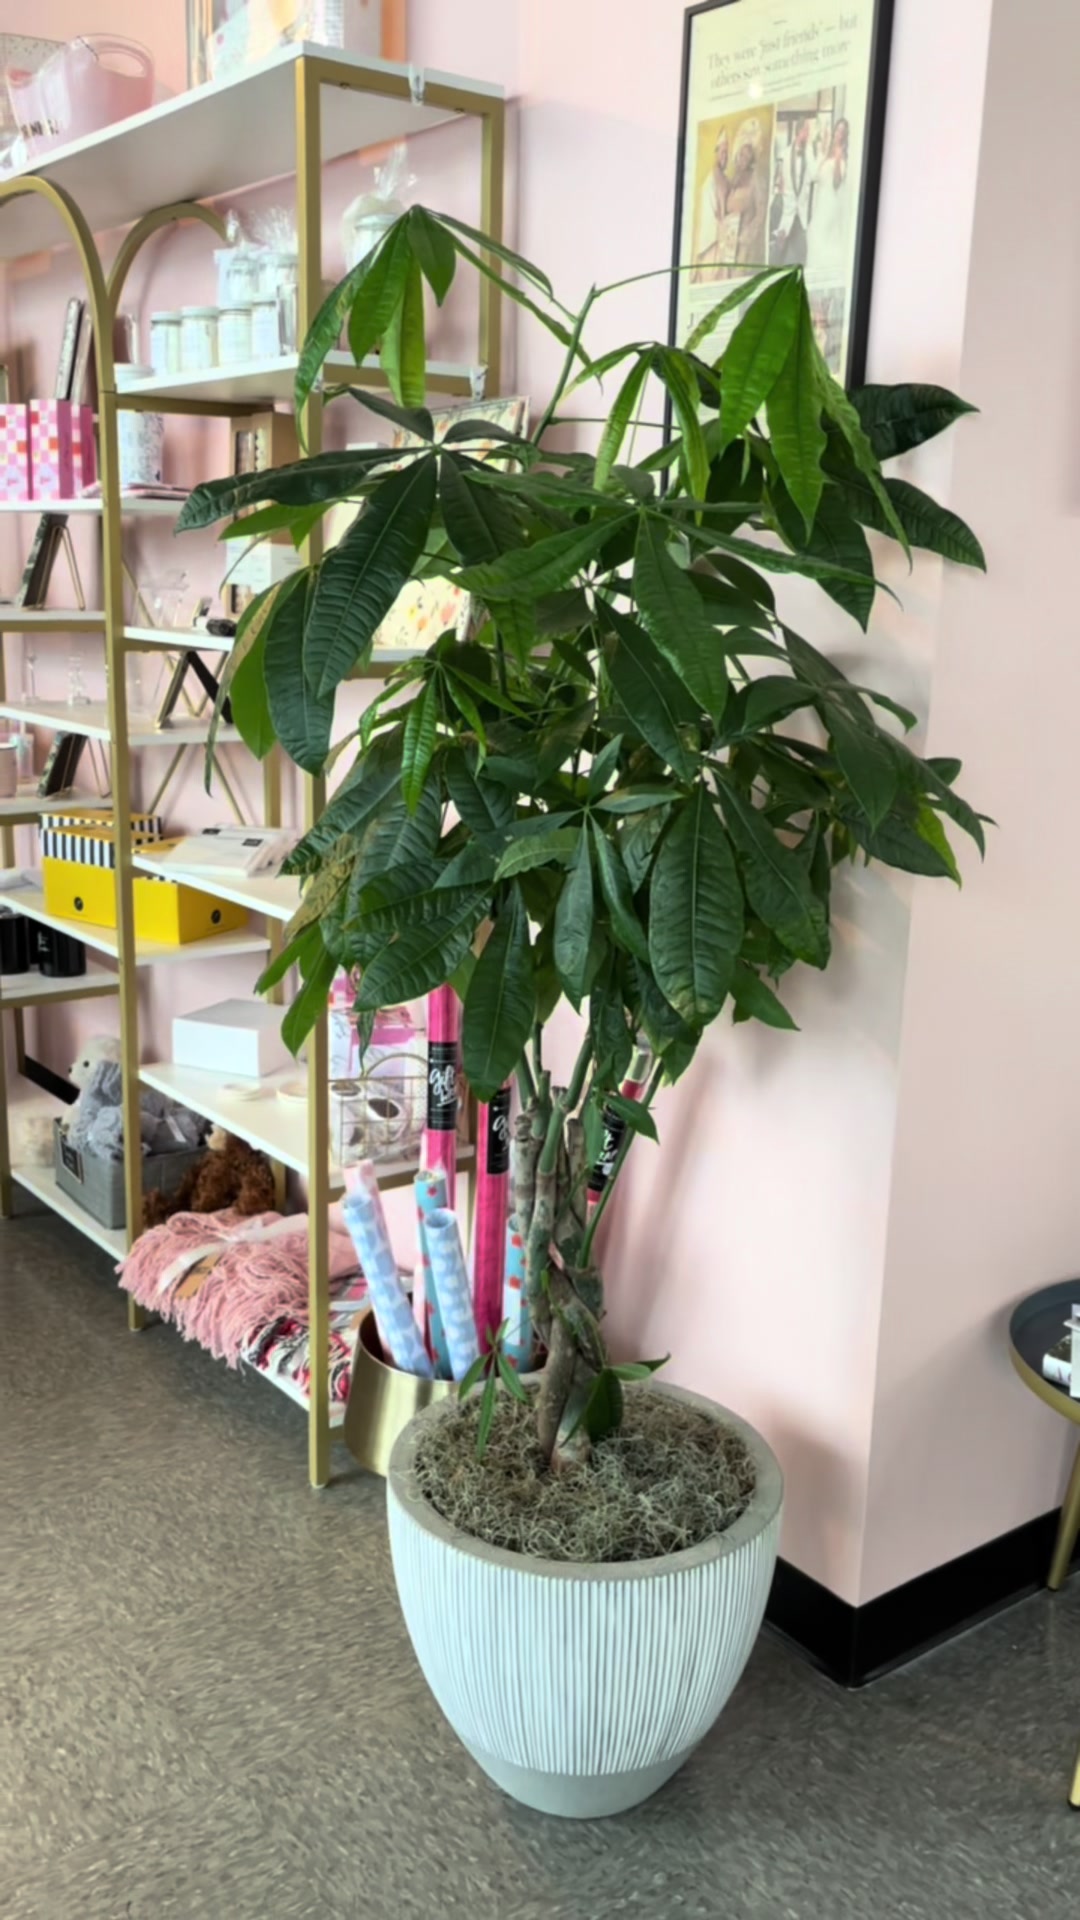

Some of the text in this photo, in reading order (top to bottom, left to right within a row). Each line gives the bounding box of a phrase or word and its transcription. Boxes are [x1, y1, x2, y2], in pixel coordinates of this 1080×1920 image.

[706, 52, 731, 70] They
[838, 12, 858, 32] but
[764, 47, 819, 71] something
[822, 40, 852, 58] more
